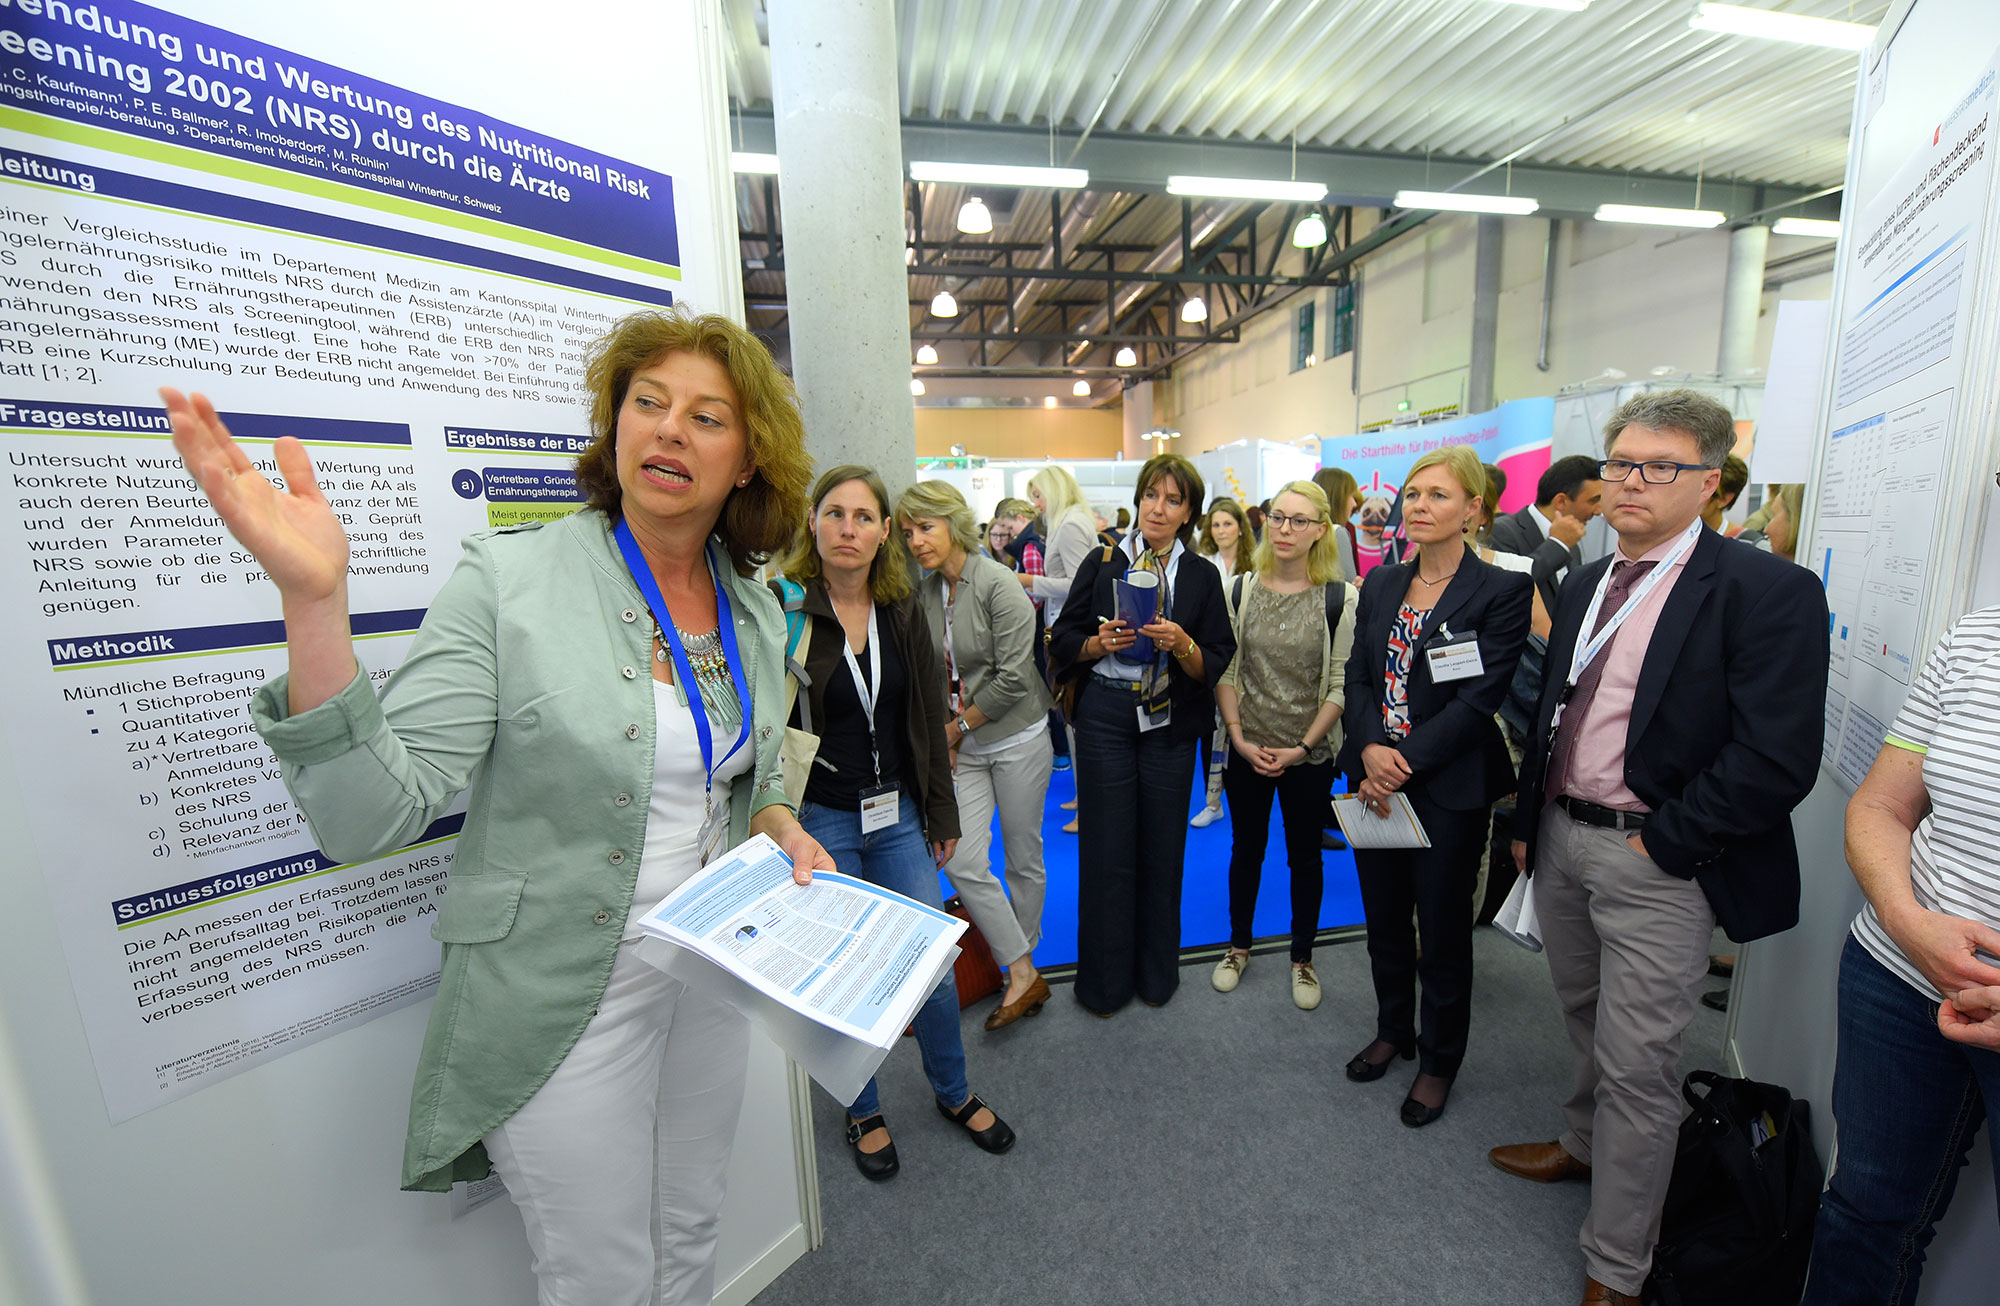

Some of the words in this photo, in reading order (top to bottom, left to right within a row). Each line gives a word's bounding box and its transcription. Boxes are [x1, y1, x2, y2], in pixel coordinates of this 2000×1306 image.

[12, 67, 31, 83] C.
[133, 97, 147, 111] P.
[151, 102, 167, 116] E.
[237, 123, 252, 137] R.
[333, 148, 347, 161] M.
[195, 43, 266, 81] und
[274, 61, 413, 129] Wertung
[421, 110, 471, 142] des
[478, 125, 601, 184] Nutritional
[605, 167, 650, 200] Risk
[163, 67, 254, 115] 2002
[265, 95, 361, 149] (NRS)
[371, 128, 455, 170] durch
[463, 154, 502, 182] die
[509, 167, 570, 202] Ärzte
[1927, 112, 1988, 185] flächendeckend
[278, 147, 328, 171] Medizin,
[331, 161, 405, 188] Kantonsspital
[406, 180, 461, 204] Winterthur,
[463, 195, 502, 213] Schweiz
[63, 216, 227, 256] Vergleichsstudie
[240, 250, 261, 262] im
[273, 252, 376, 282] Departement
[386, 272, 441, 293] Medizin
[449, 286, 470, 298] am
[478, 289, 557, 314] Kantonsspital
[221, 265, 278, 283] mittels
[285, 273, 324, 291] NRS
[330, 281, 374, 299] durch
[380, 290, 402, 303] die
[408, 294, 503, 319] Assistenzärzte
[508, 311, 535, 327] (AA)
[539, 316, 553, 328] im
[233, 323, 300, 344] festlegt.
[313, 332, 348, 348] Eine
[360, 338, 397, 354] hohe
[408, 344, 440, 359] Rate
[450, 352, 474, 363] von
[484, 355, 519, 369] >70%
[527, 360, 547, 372] der
[41, 363, 69, 381] [1;
[76, 366, 102, 384] 2].
[44, 346, 90, 360] eine
[100, 348, 232, 375] Kurzschulung
[240, 364, 267, 375] zur
[274, 364, 361, 387] Bedeutung
[367, 376, 395, 388] und
[401, 377, 480, 398] Anwendung
[485, 386, 508, 398] des
[512, 388, 540, 401] NRS
[544, 394, 576, 405] sowie
[0, 404, 172, 429] Fragestellun
[448, 431, 534, 449] Ergebnisse
[540, 437, 564, 450] der
[8, 451, 127, 468] Untersucht
[135, 456, 183, 469] wurd
[13, 473, 107, 488] konkrete
[115, 475, 198, 492] Nutzung
[461, 479, 475, 493] a)
[485, 474, 539, 484] Vertretbare
[543, 475, 576, 485] Gründe
[487, 486, 578, 498] Ernährungstherapie
[491, 510, 518, 519] Meist
[519, 510, 565, 521] genannter
[32, 557, 84, 572] NRS
[94, 555, 152, 569] sowie
[161, 553, 185, 567] ob
[194, 552, 221, 565] die
[38, 577, 136, 593] Anleitung
[156, 573, 181, 586] für
[200, 571, 227, 584] die
[42, 597, 140, 617] genügen.
[53, 634, 175, 660] Methodik
[63, 679, 167, 701] Mündliche
[172, 668, 265, 688] Befragung
[118, 701, 127, 713] 1
[122, 707, 240, 733] Quantitativer
[126, 740, 150, 753] zu
[155, 734, 167, 747] 4
[173, 718, 258, 744] Kategorie
[161, 740, 258, 764] Vertretbare
[167, 757, 264, 782] Anmeldung
[139, 791, 158, 806] b)
[170, 775, 257, 799] Konkretes
[178, 808, 258, 833] Schulung
[262, 801, 288, 814] der
[148, 826, 165, 841] c)
[192, 836, 266, 859] Mehrfachantwort
[267, 828, 300, 841] möglich
[118, 858, 318, 921] Schlussfolgerung
[123, 939, 156, 956] Die
[163, 927, 191, 945] AA
[194, 908, 262, 935] messen
[267, 899, 294, 913] der
[299, 876, 375, 908] Erfassung
[379, 868, 405, 881] des
[408, 855, 440, 873] NRS
[133, 967, 178, 990] nicht
[189, 929, 309, 972] angemeldeten
[318, 892, 427, 933] Risikopatienten
[141, 984, 237, 1024] verbessert
[240, 965, 301, 991] werden
[306, 944, 369, 970] müssen.
[155, 1038, 241, 1072] Literaturverzeichnis
